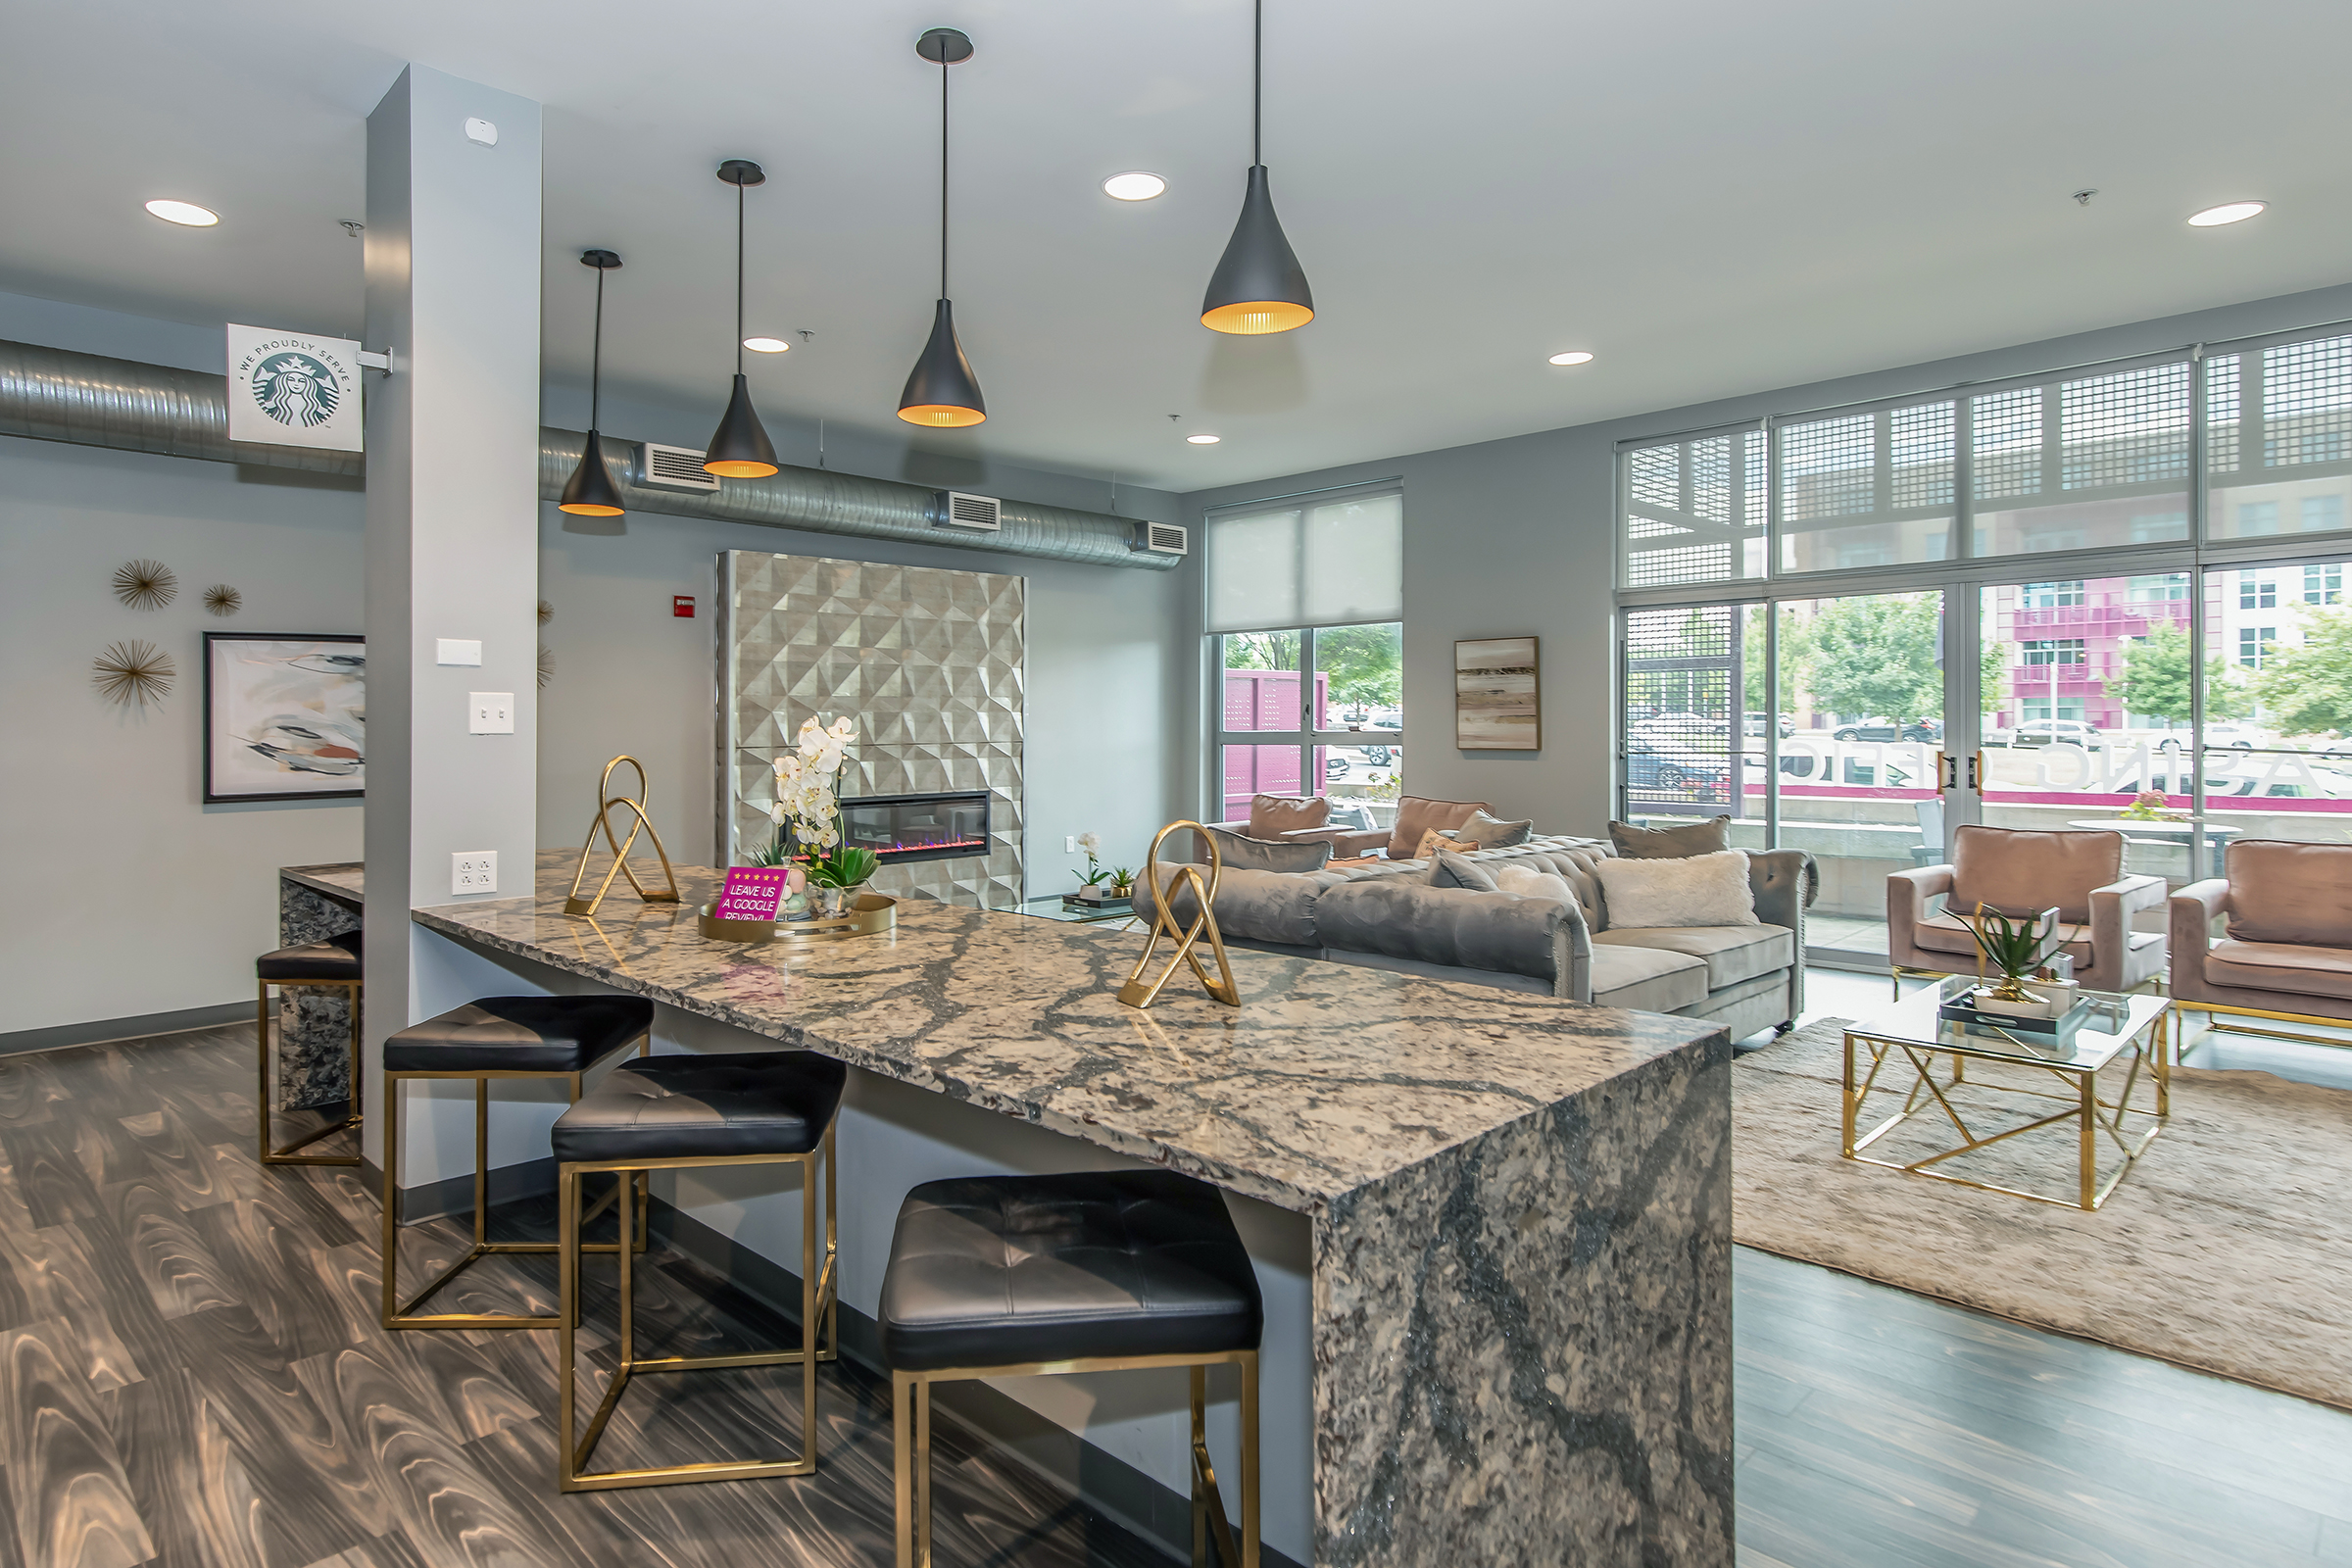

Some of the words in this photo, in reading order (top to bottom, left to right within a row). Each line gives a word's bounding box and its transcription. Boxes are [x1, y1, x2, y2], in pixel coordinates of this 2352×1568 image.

[240, 355, 255, 371] WE
[255, 339, 315, 356] PROUDLY
[318, 350, 350, 382] SERVE
[730, 884, 760, 896] LEAVE
[761, 887, 775, 897] US
[721, 898, 731, 908] A
[733, 899, 776, 911] GOOGLE
